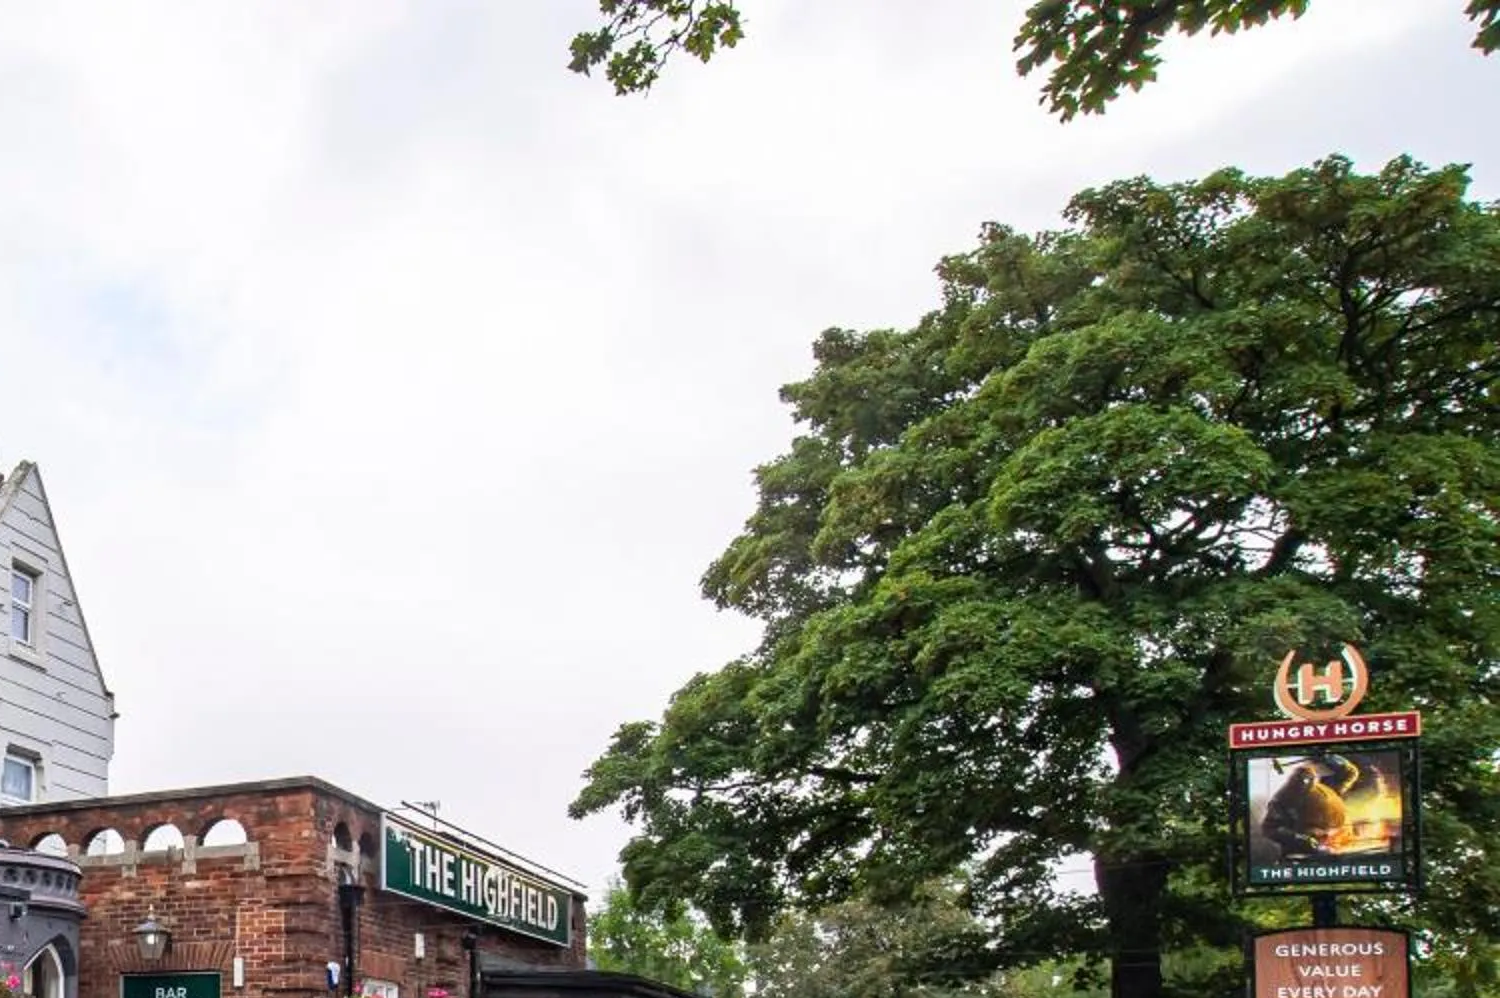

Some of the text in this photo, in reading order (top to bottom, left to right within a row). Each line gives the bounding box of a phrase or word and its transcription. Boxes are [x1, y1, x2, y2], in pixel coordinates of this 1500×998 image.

[1241, 719, 1408, 741] HUNGRY HORSE
[1260, 863, 1392, 879] THE HIGHFIELD
[406, 838, 559, 932] THE HIGHFIELD
[1275, 942, 1384, 957] GENEROUS
[1299, 964, 1362, 977] VALUE
[1277, 984, 1382, 998] EVERY DAY
